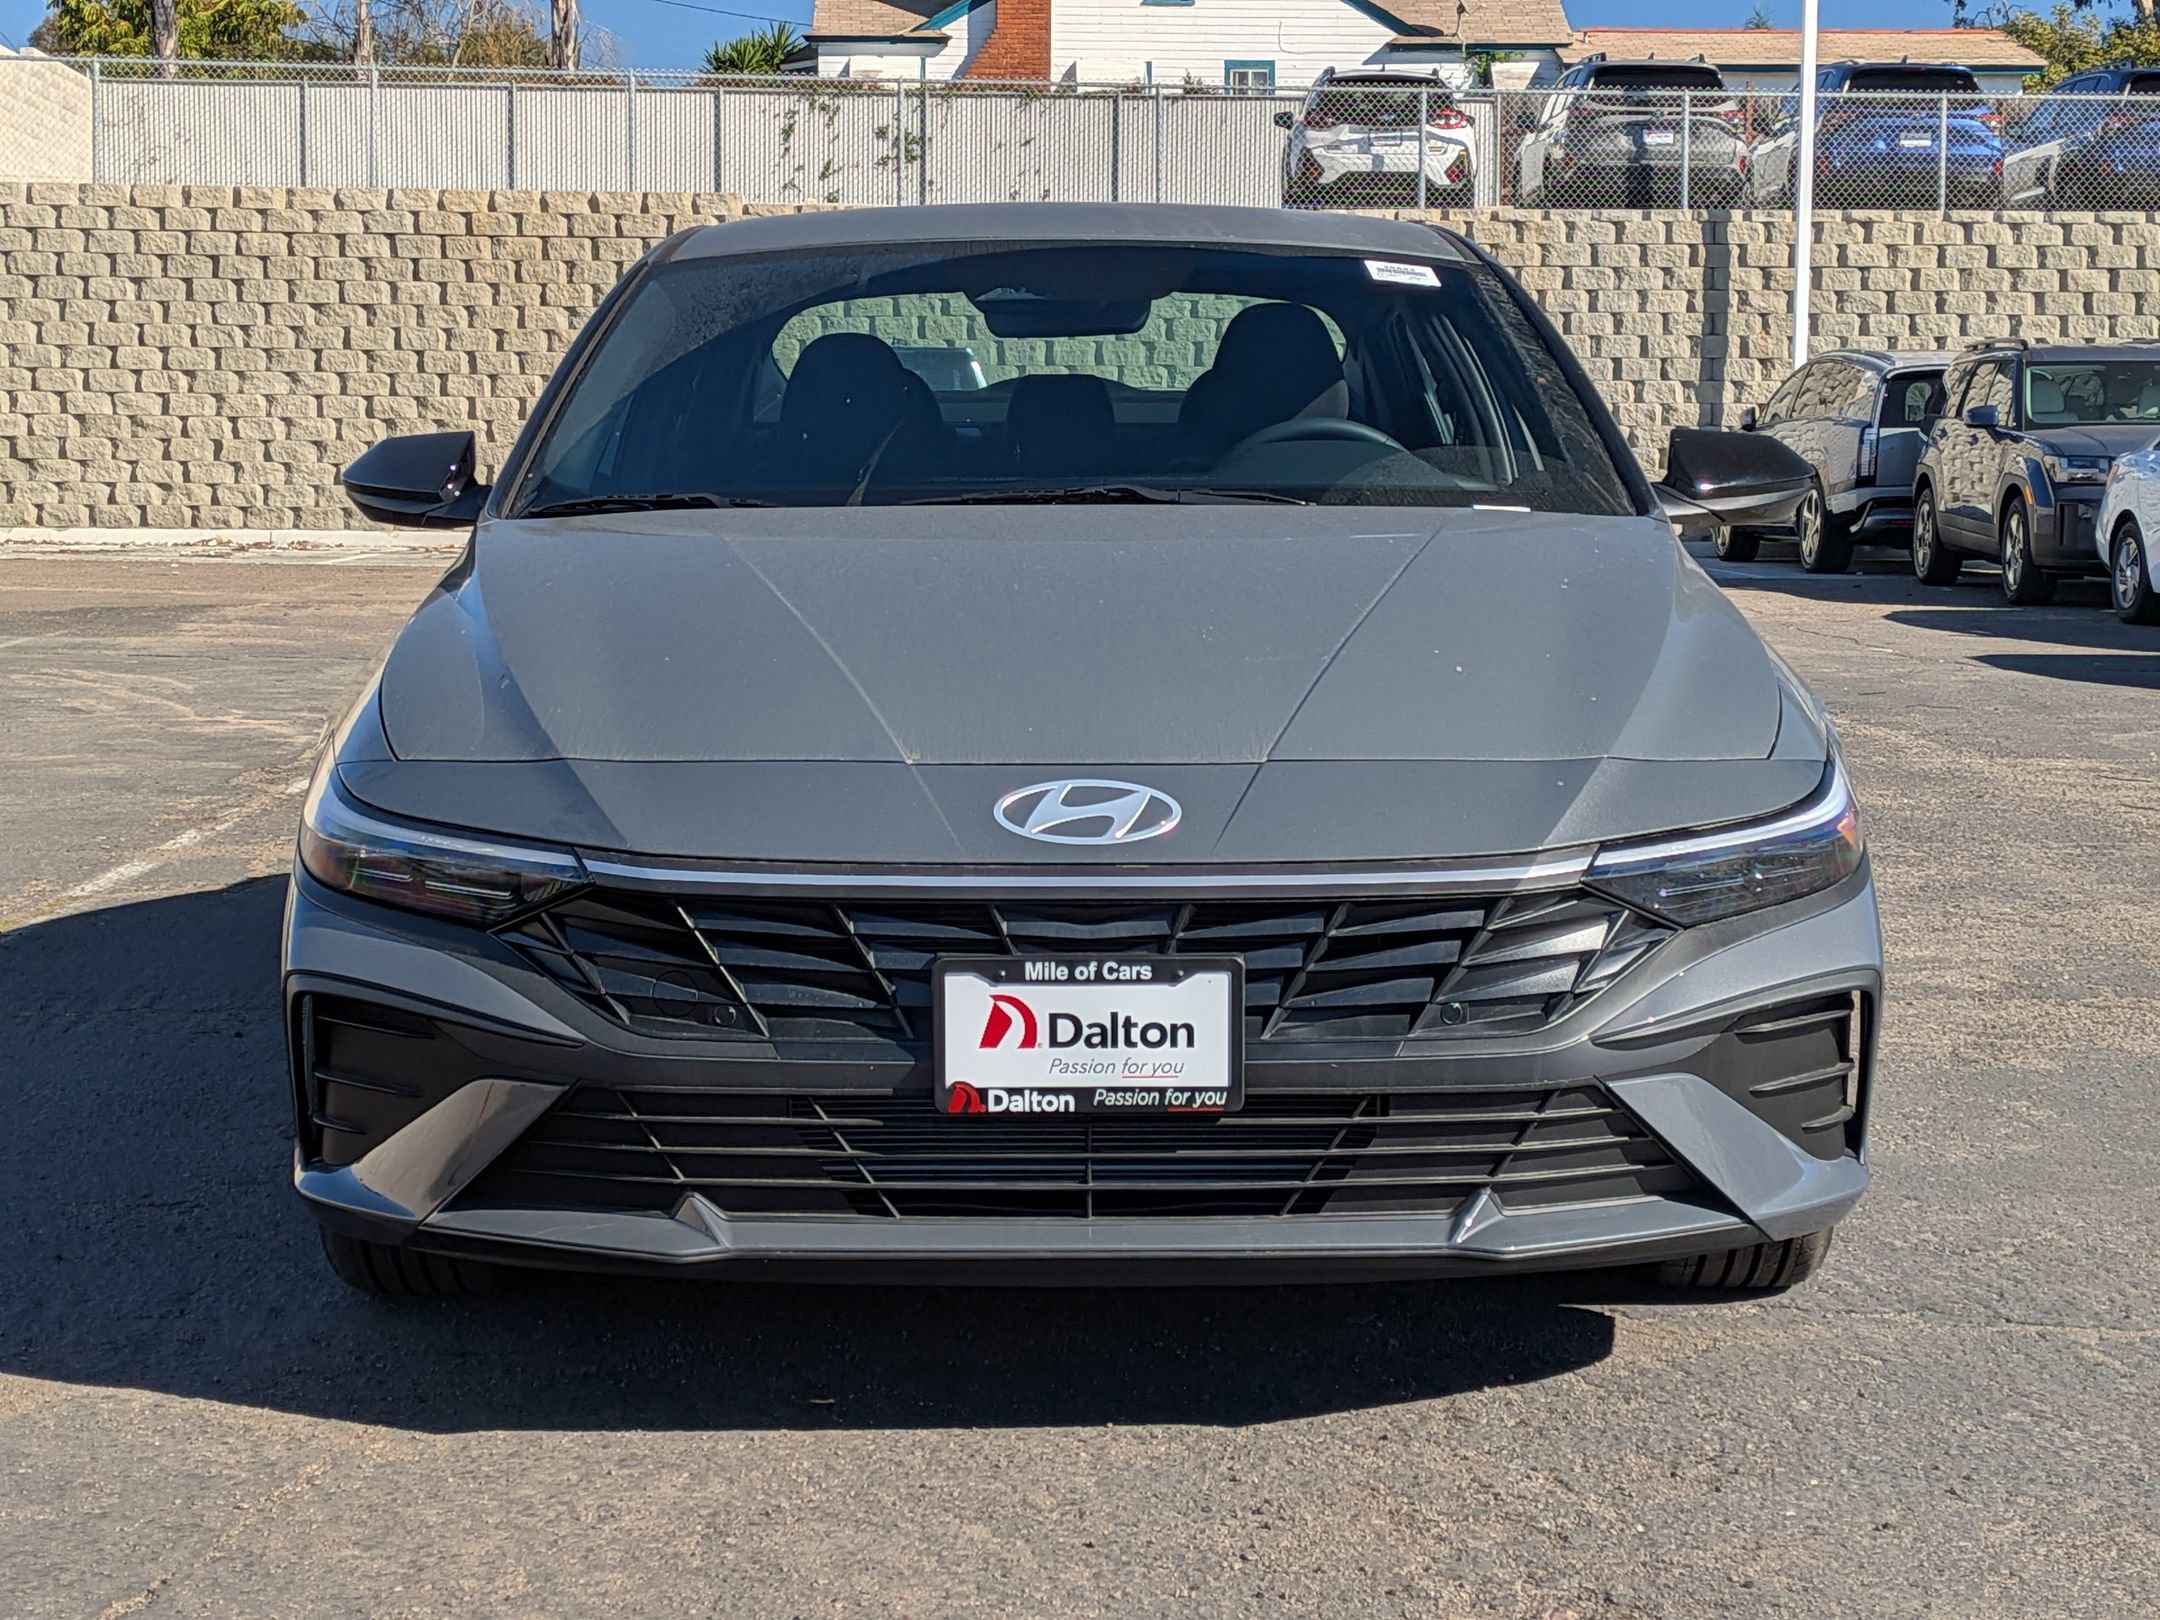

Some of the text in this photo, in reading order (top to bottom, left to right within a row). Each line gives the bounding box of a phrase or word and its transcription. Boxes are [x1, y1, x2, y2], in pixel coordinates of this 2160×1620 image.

[1025, 962, 1152, 981] Mile of Cars
[1049, 1012, 1194, 1048] Dalton
[1049, 1057, 1184, 1077] Passion for you
[988, 1090, 1075, 1113] Dalton
[1093, 1088, 1227, 1109] Passion for you
